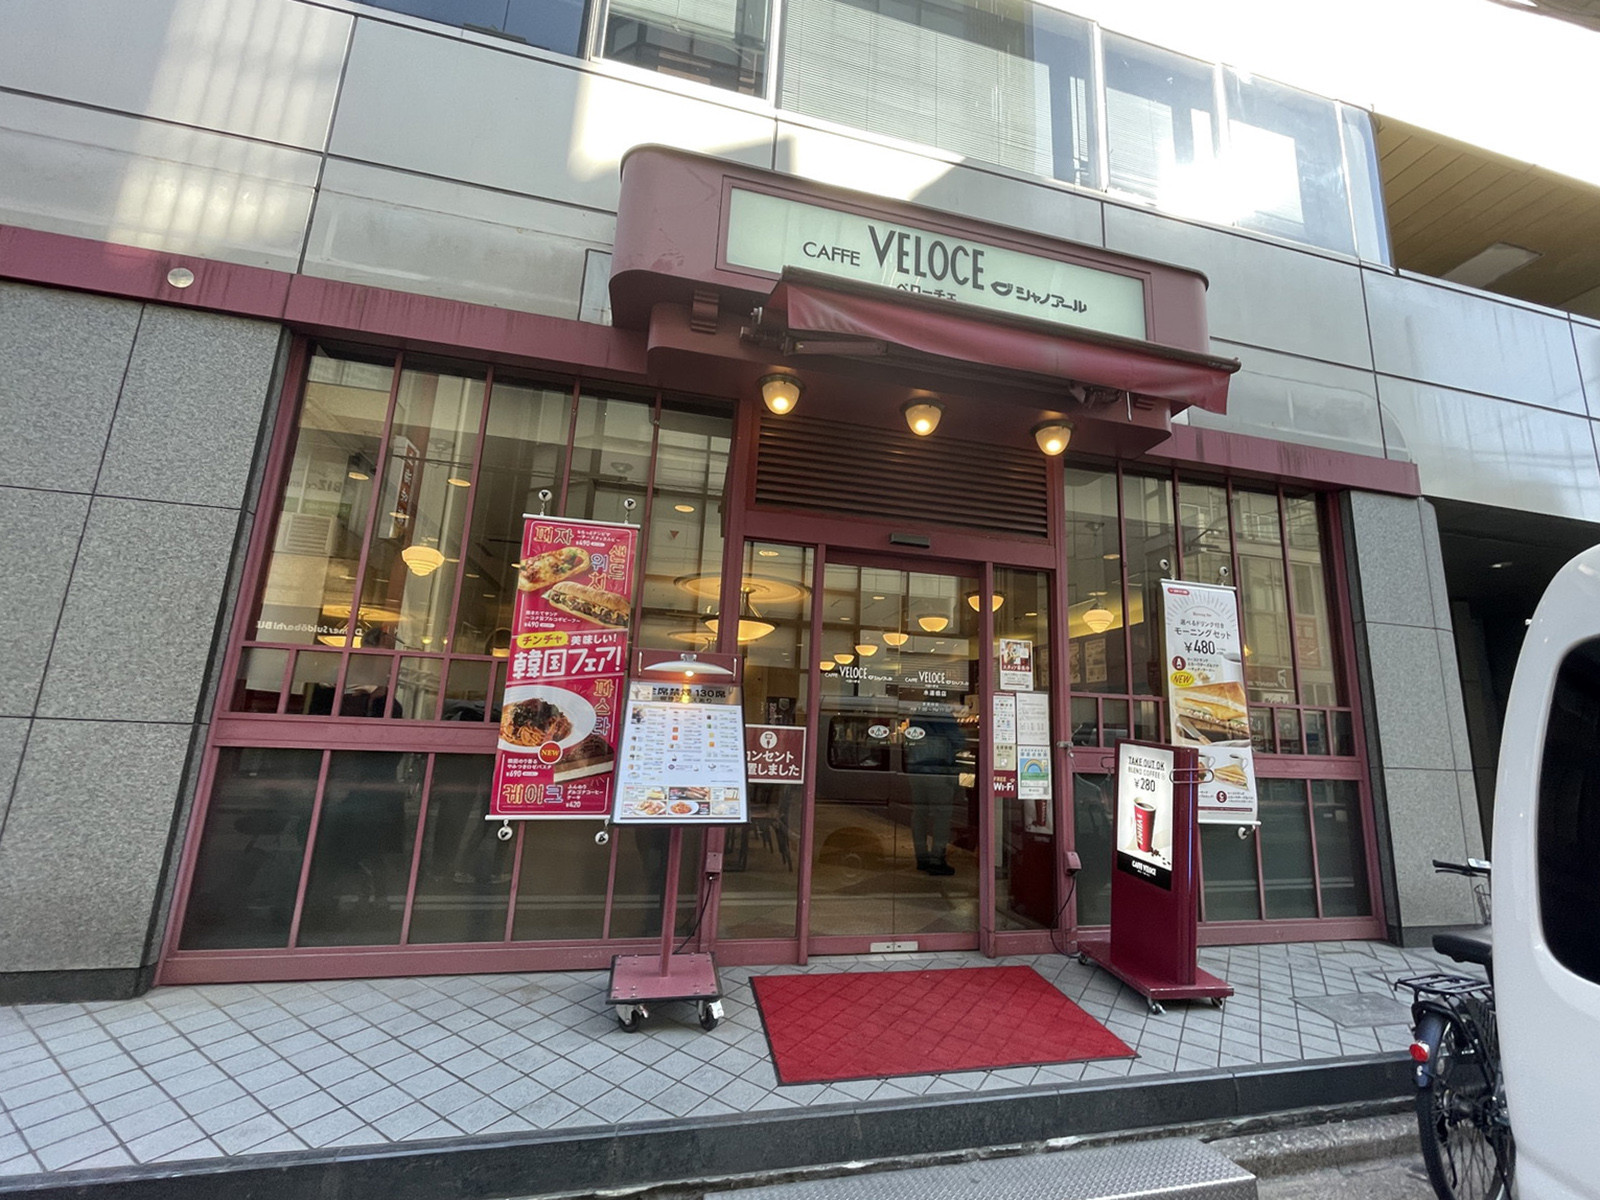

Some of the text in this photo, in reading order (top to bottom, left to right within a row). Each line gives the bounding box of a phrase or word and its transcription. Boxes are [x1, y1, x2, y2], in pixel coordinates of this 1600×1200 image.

[803, 225, 985, 291] CAFFE VELOCE
[1016, 286, 1087, 313] シャノアール
[522, 634, 562, 646] チンチャ
[1174, 627, 1231, 639] モーニングセット
[1184, 639, 1216, 655] ¥480
[512, 645, 622, 679] 韓国フェア!
[839, 666, 867, 680] VELOCE
[918, 671, 946, 684] VELOCE
[1174, 675, 1192, 684] NEW
[540, 748, 560, 757] NEW
[1128, 756, 1165, 771] TAKE OUT OK
[993, 782, 1015, 791] Wi-Fi
[1134, 777, 1155, 792] ¥280
[502, 783, 563, 805] 케이크
